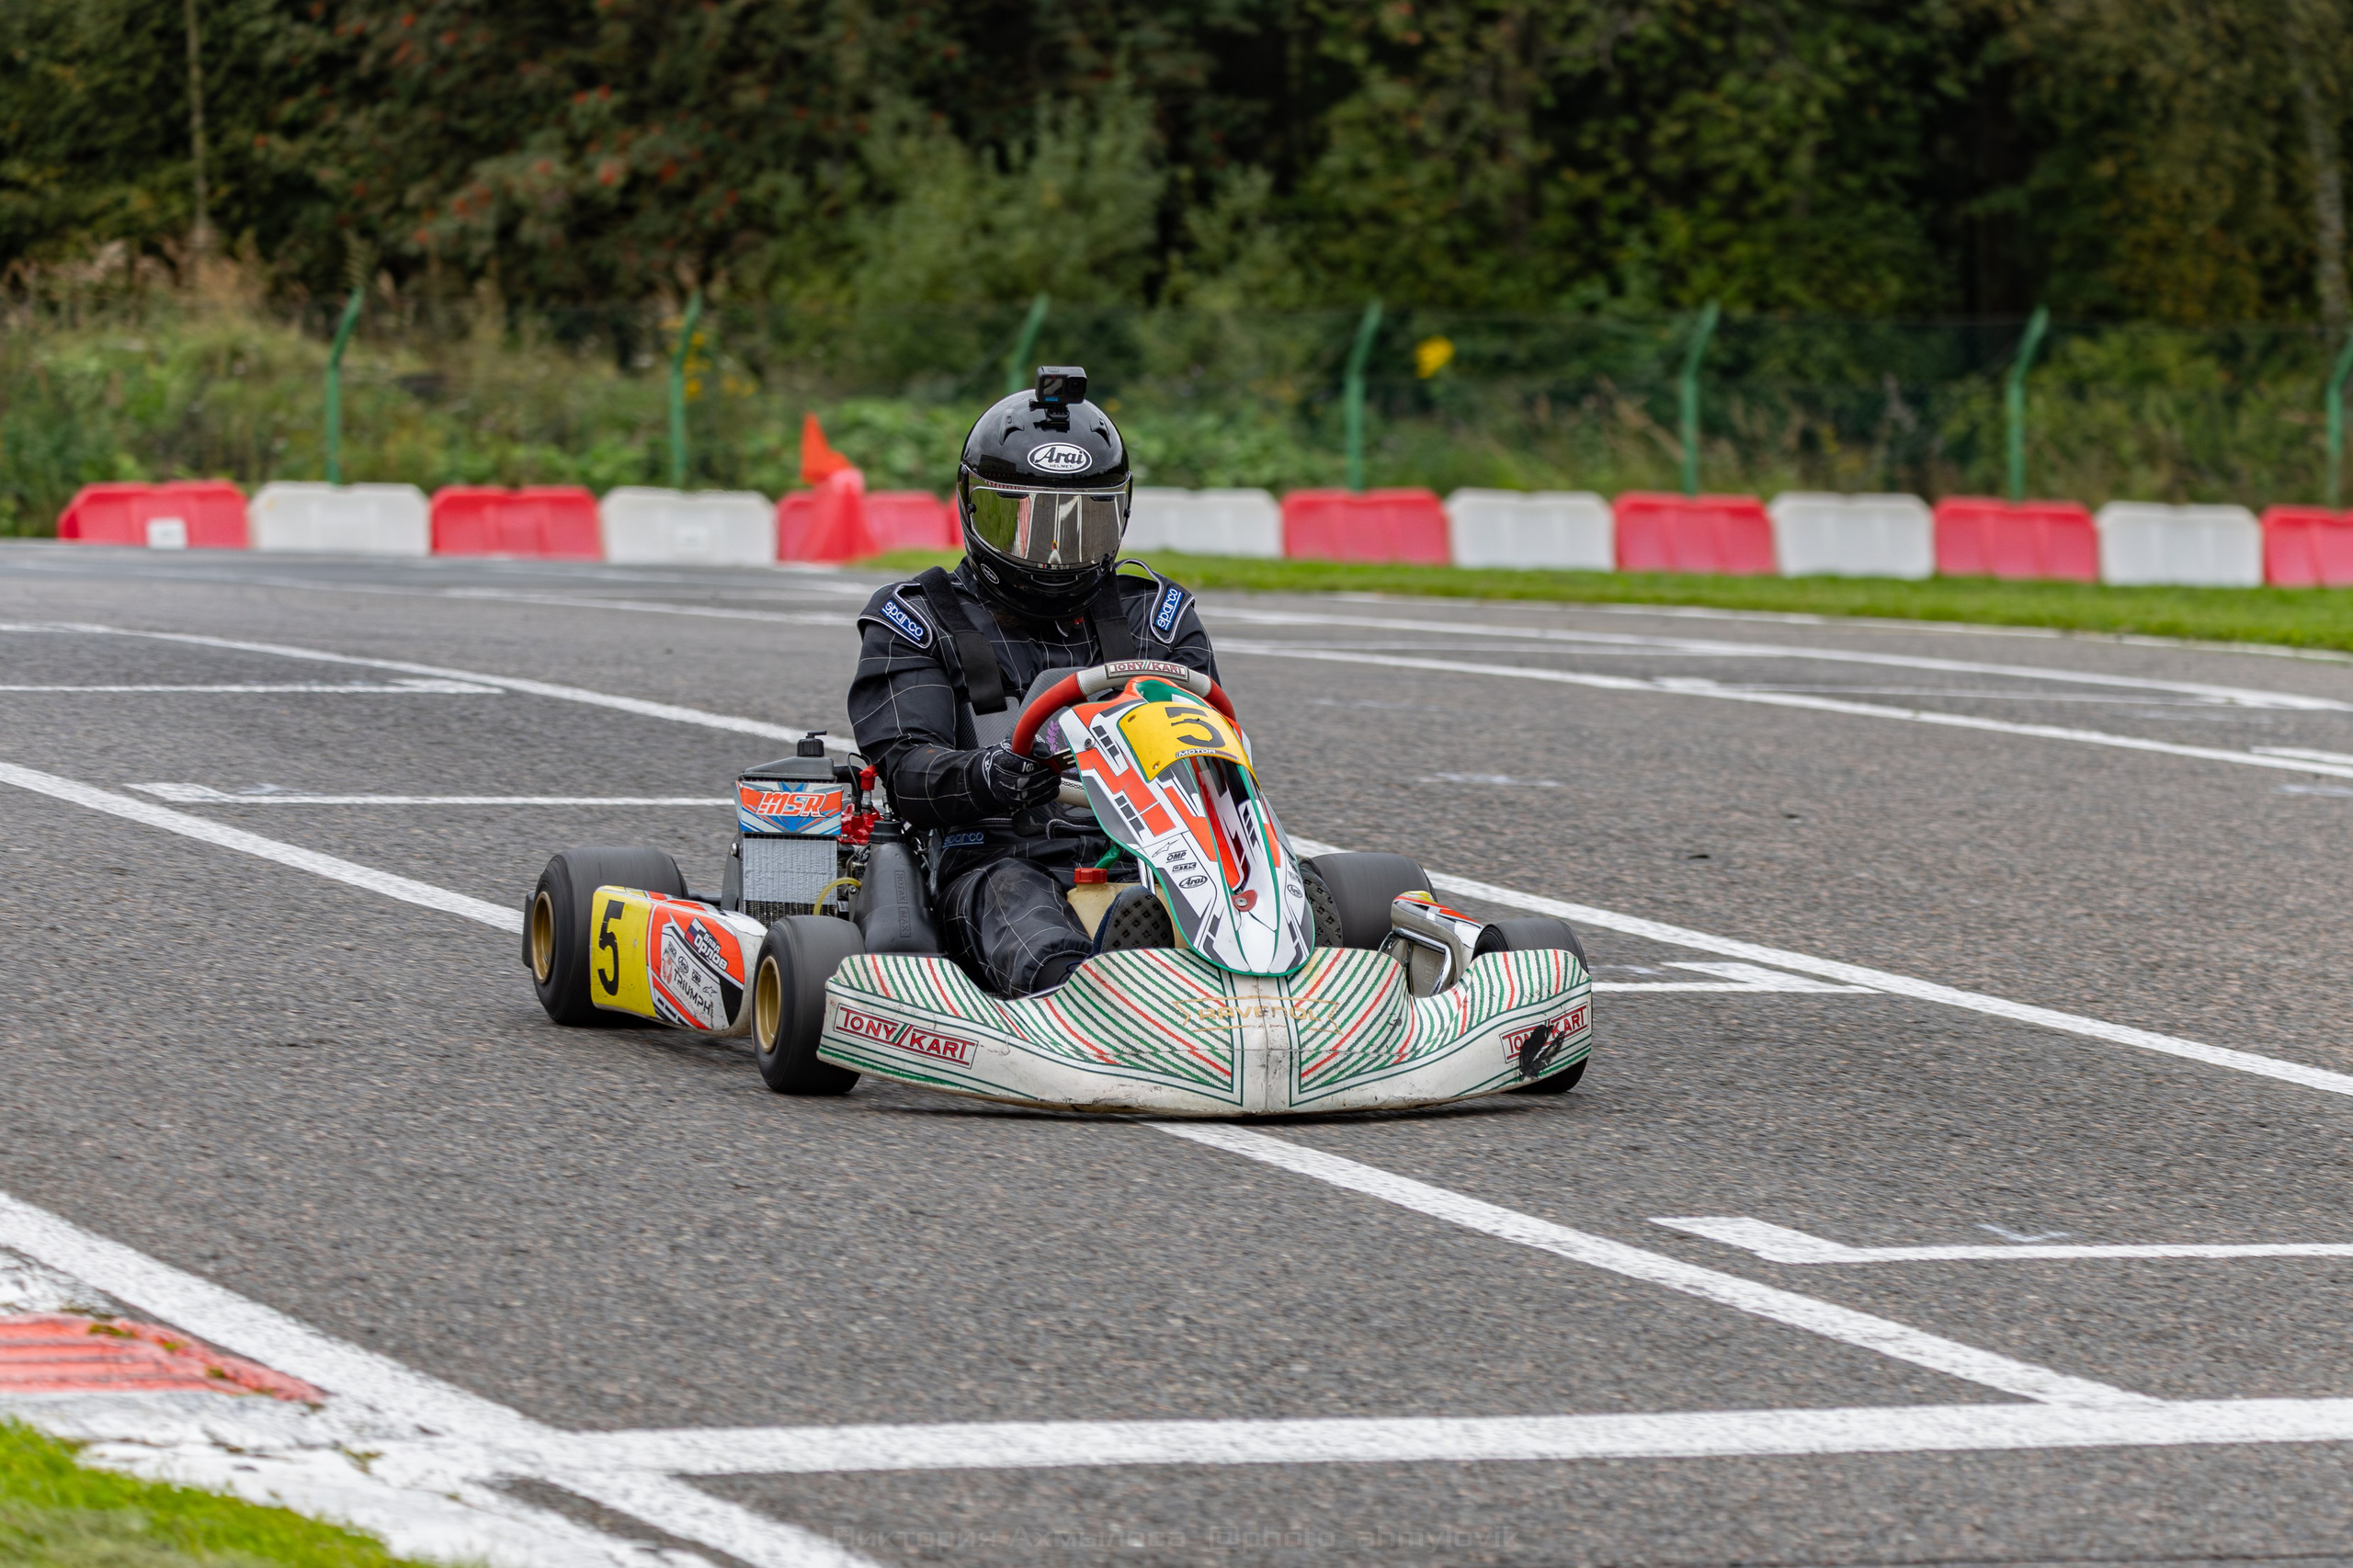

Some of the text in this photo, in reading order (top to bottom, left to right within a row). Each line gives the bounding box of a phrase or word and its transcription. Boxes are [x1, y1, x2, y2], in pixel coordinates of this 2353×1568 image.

[1034, 446, 1084, 465] Arai
[884, 601, 924, 637] sparco
[1157, 588, 1178, 628] sparco
[1165, 707, 1226, 748] 5
[756, 791, 826, 818] MSR
[944, 832, 984, 846] sparco
[1166, 851, 1187, 861] OMP
[1181, 876, 1205, 887] Arai
[900, 910, 909, 933] MAX
[597, 899, 625, 996] 5
[694, 934, 728, 971] Орлов
[702, 932, 722, 953] Влад
[840, 1006, 975, 1060] TONY KART
[1552, 1005, 1587, 1039] KART
